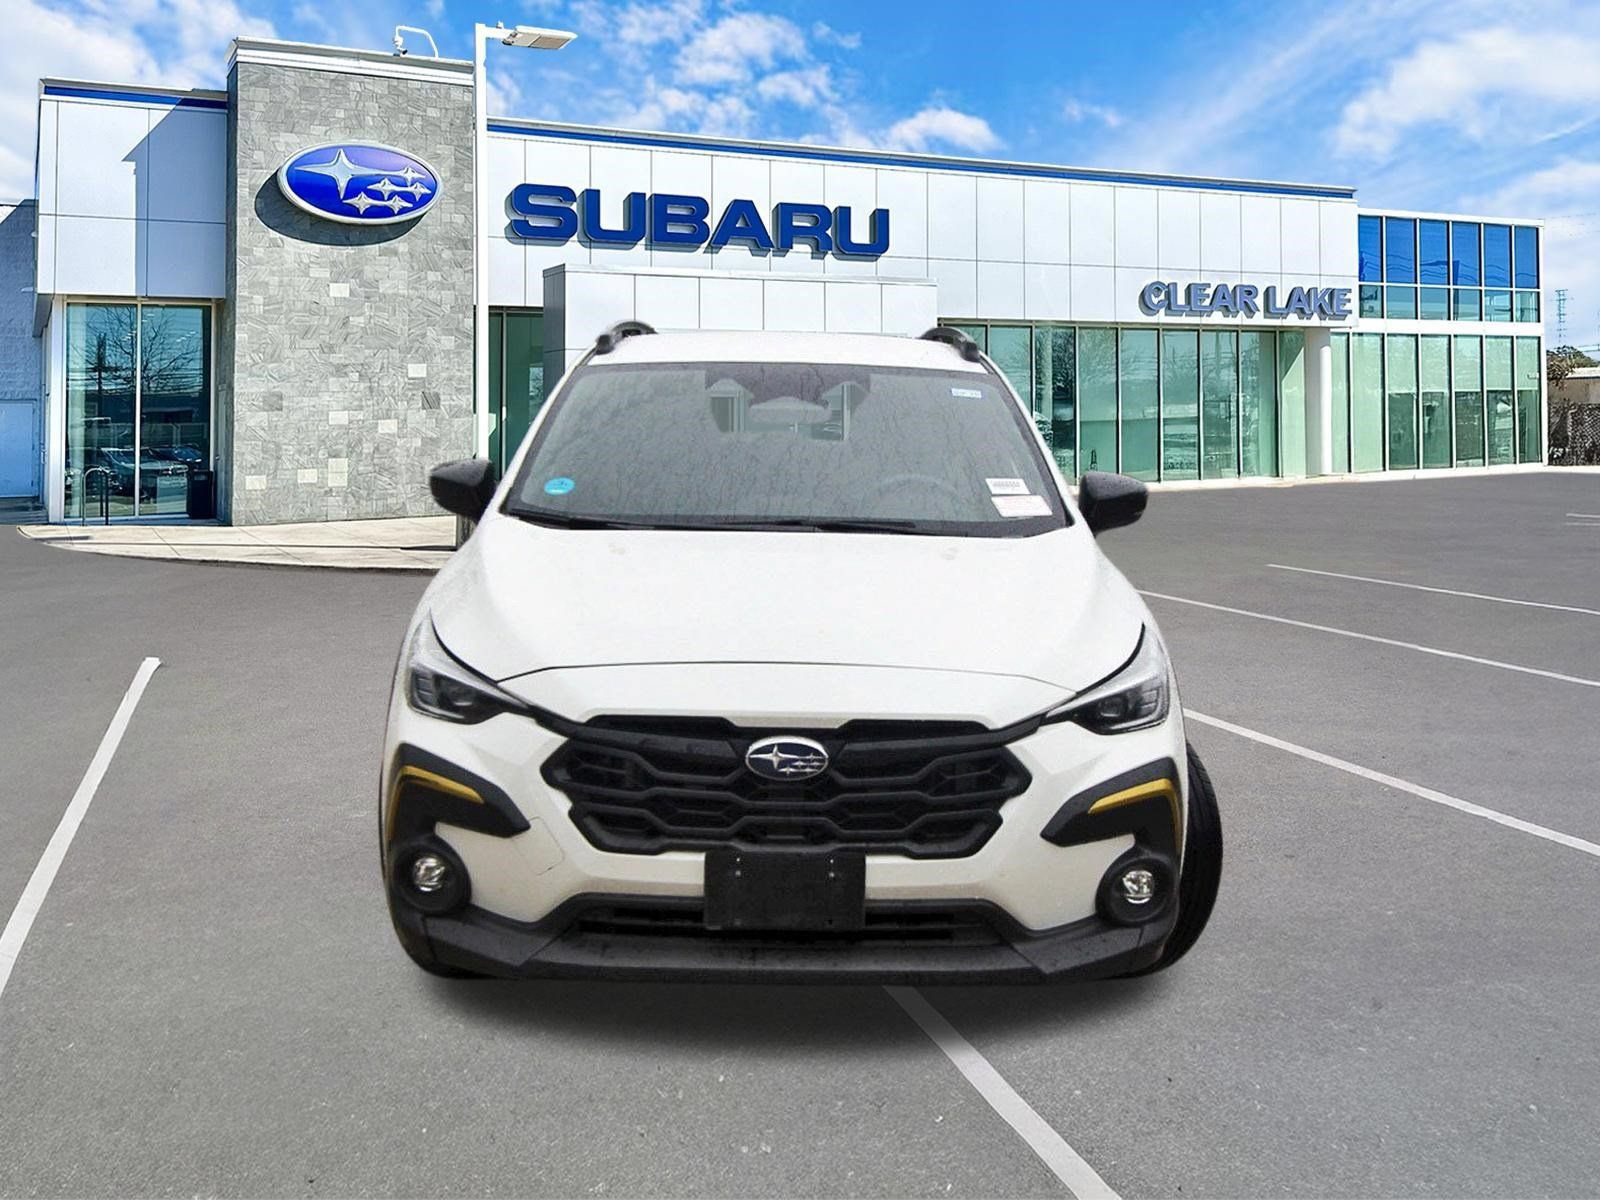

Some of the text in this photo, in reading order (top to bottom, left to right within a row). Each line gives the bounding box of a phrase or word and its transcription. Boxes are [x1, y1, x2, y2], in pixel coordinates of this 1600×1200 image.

[506, 183, 890, 259] SUBARU
[1140, 281, 1353, 319] CLEAR LAKE
